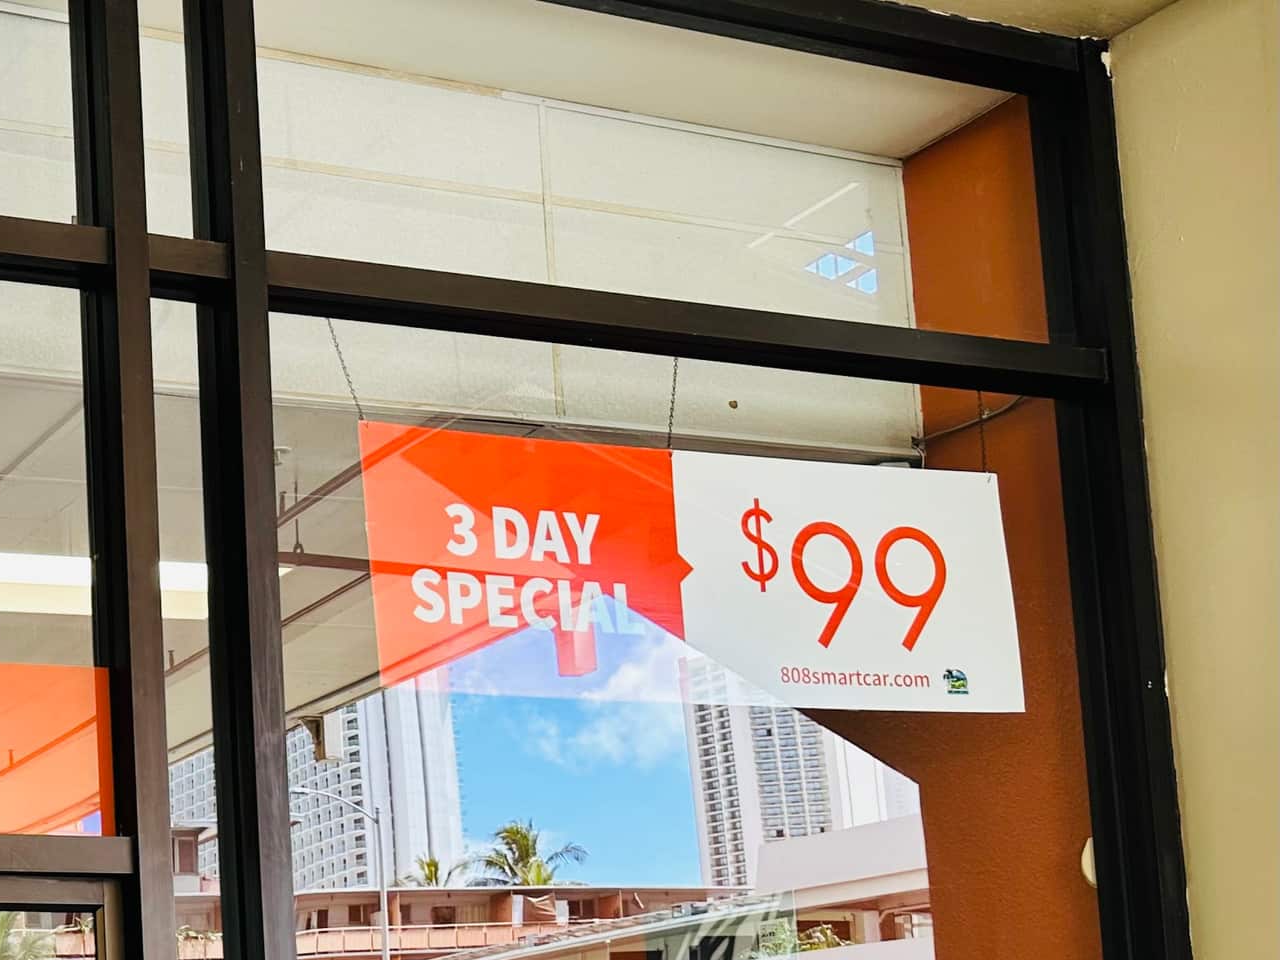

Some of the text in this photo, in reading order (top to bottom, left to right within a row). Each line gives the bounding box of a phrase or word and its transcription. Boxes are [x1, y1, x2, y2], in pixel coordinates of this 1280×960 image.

[445, 503, 600, 566] 3 DAY
[411, 567, 646, 636] SPECIAL
[740, 497, 948, 652] $99
[780, 665, 931, 690] 808smartcar.com
